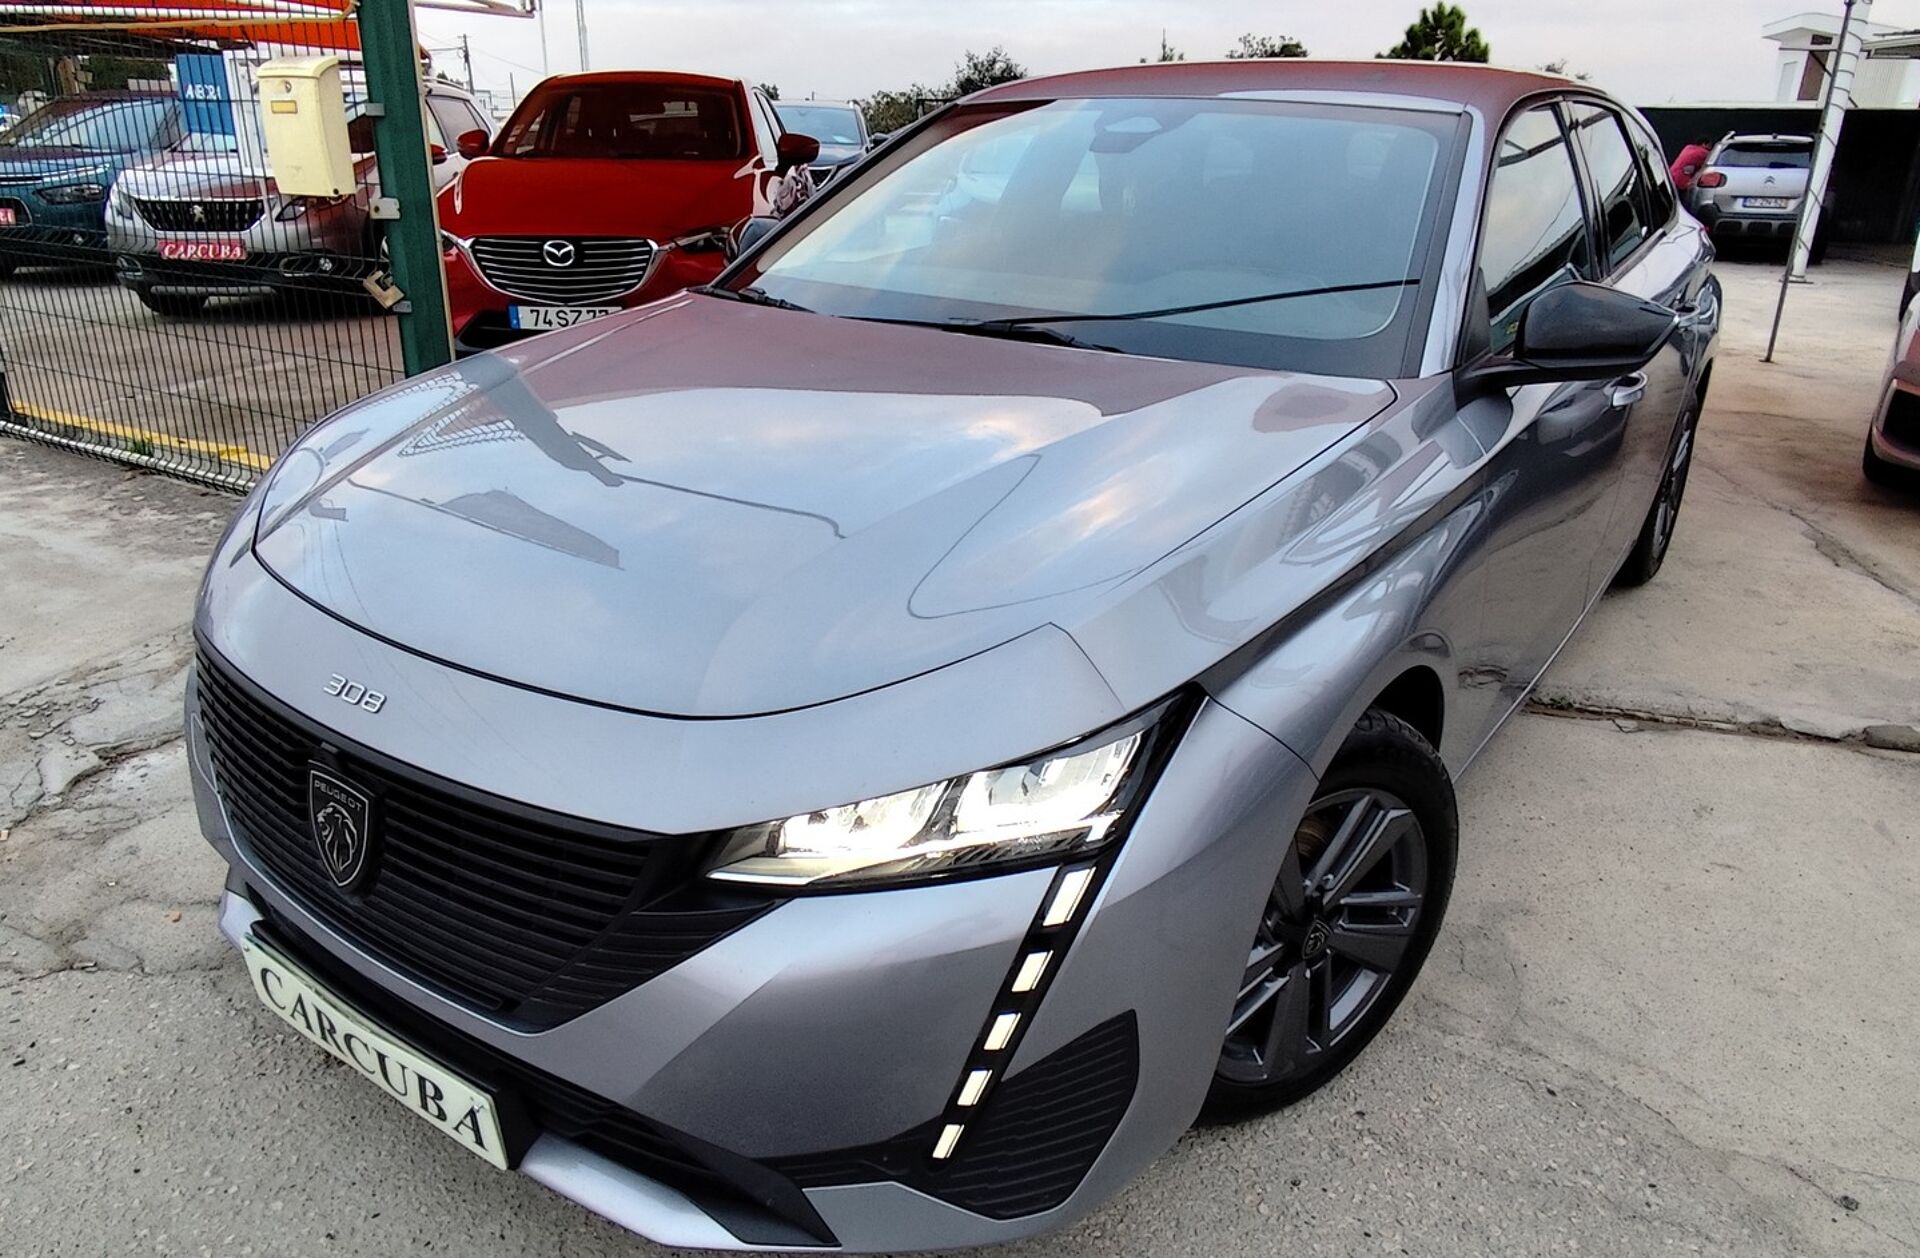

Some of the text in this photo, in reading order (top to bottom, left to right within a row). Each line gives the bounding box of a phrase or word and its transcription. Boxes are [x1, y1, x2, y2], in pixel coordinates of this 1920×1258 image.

[163, 242, 243, 260] CARCUBA
[323, 673, 386, 713] 308
[314, 779, 363, 812] PEUGEOT
[260, 967, 489, 1152] CARCUBA
